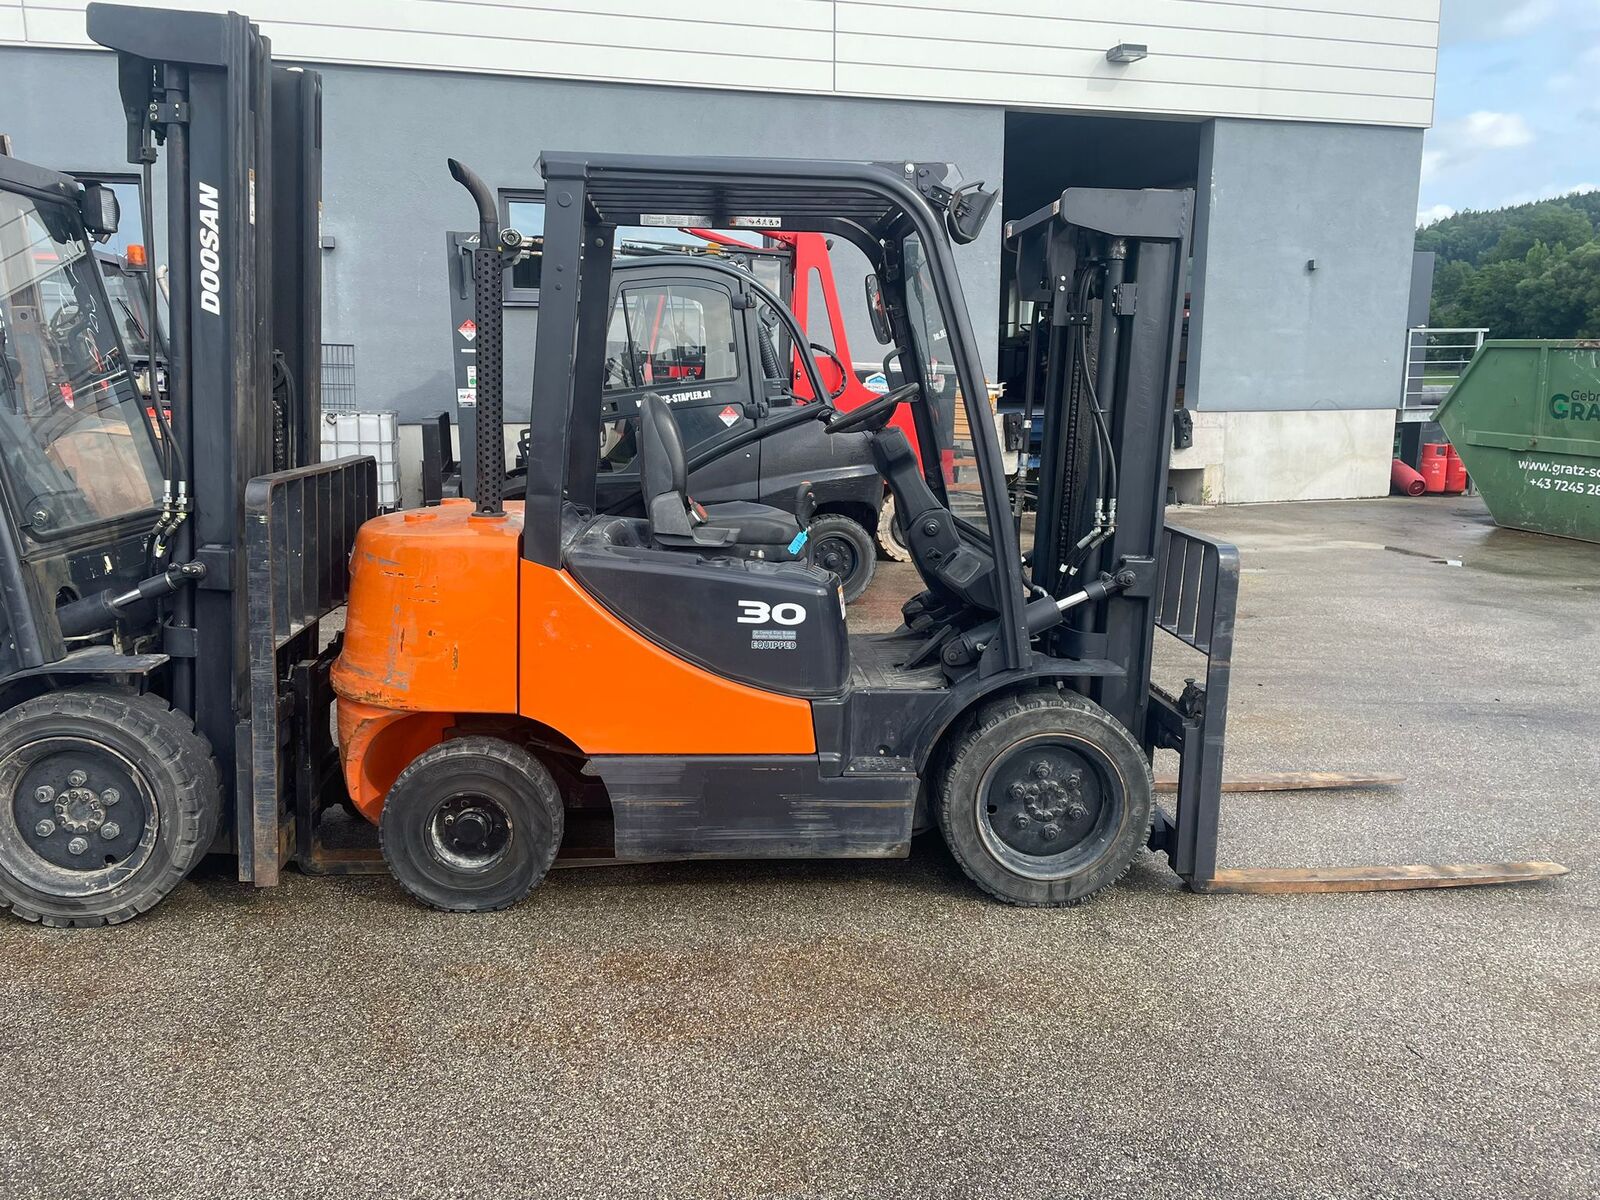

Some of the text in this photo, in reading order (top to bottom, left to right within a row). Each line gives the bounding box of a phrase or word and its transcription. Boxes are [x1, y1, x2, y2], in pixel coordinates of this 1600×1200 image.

[199, 181, 221, 316] DOOSAN
[1549, 393, 1600, 421] GRA
[1529, 477, 1552, 490] +43
[1554, 479, 1584, 494] 7245
[737, 599, 807, 626] 30
[751, 640, 797, 650] EQUIPPED
